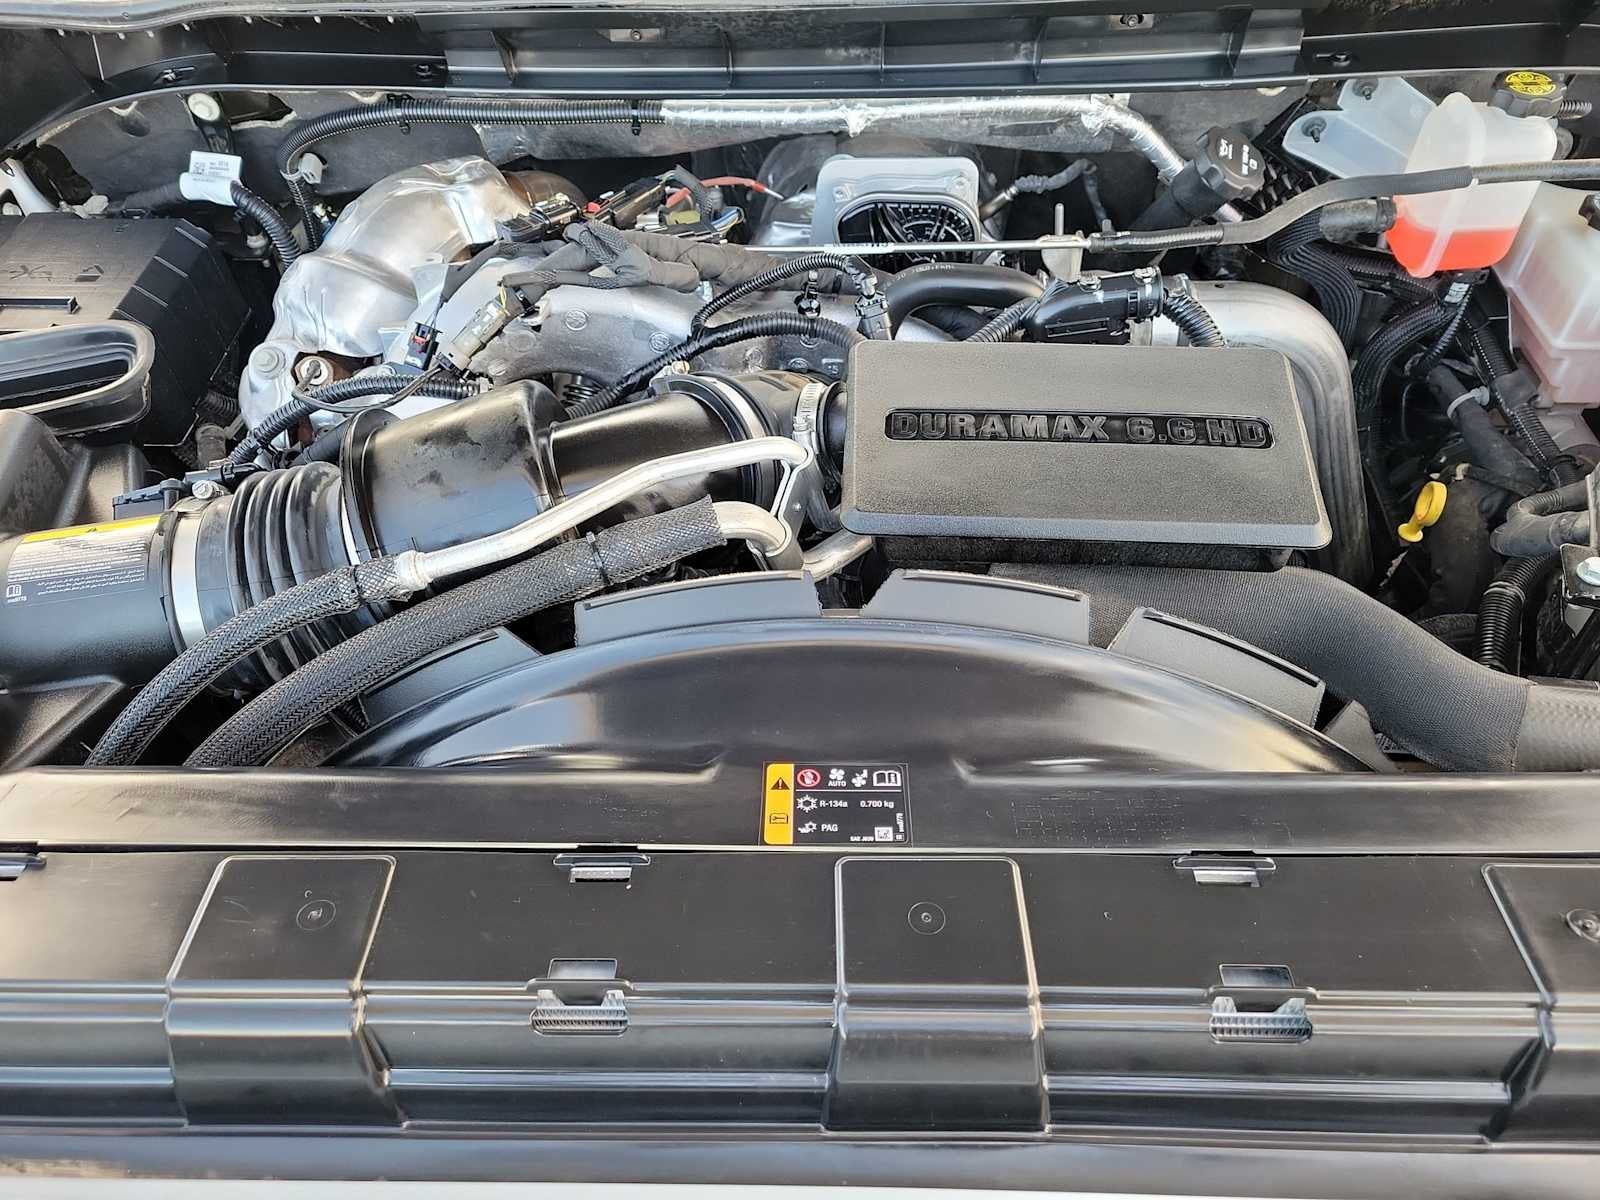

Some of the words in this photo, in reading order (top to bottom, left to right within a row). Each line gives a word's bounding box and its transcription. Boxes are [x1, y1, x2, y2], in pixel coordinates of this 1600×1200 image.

[890, 412, 1109, 442] DURAMAX
[1126, 415, 1197, 444] 6.6
[1205, 418, 1268, 447] HD
[819, 800, 848, 808] R-134a
[883, 800, 895, 809] kg
[821, 824, 838, 832] PAG
